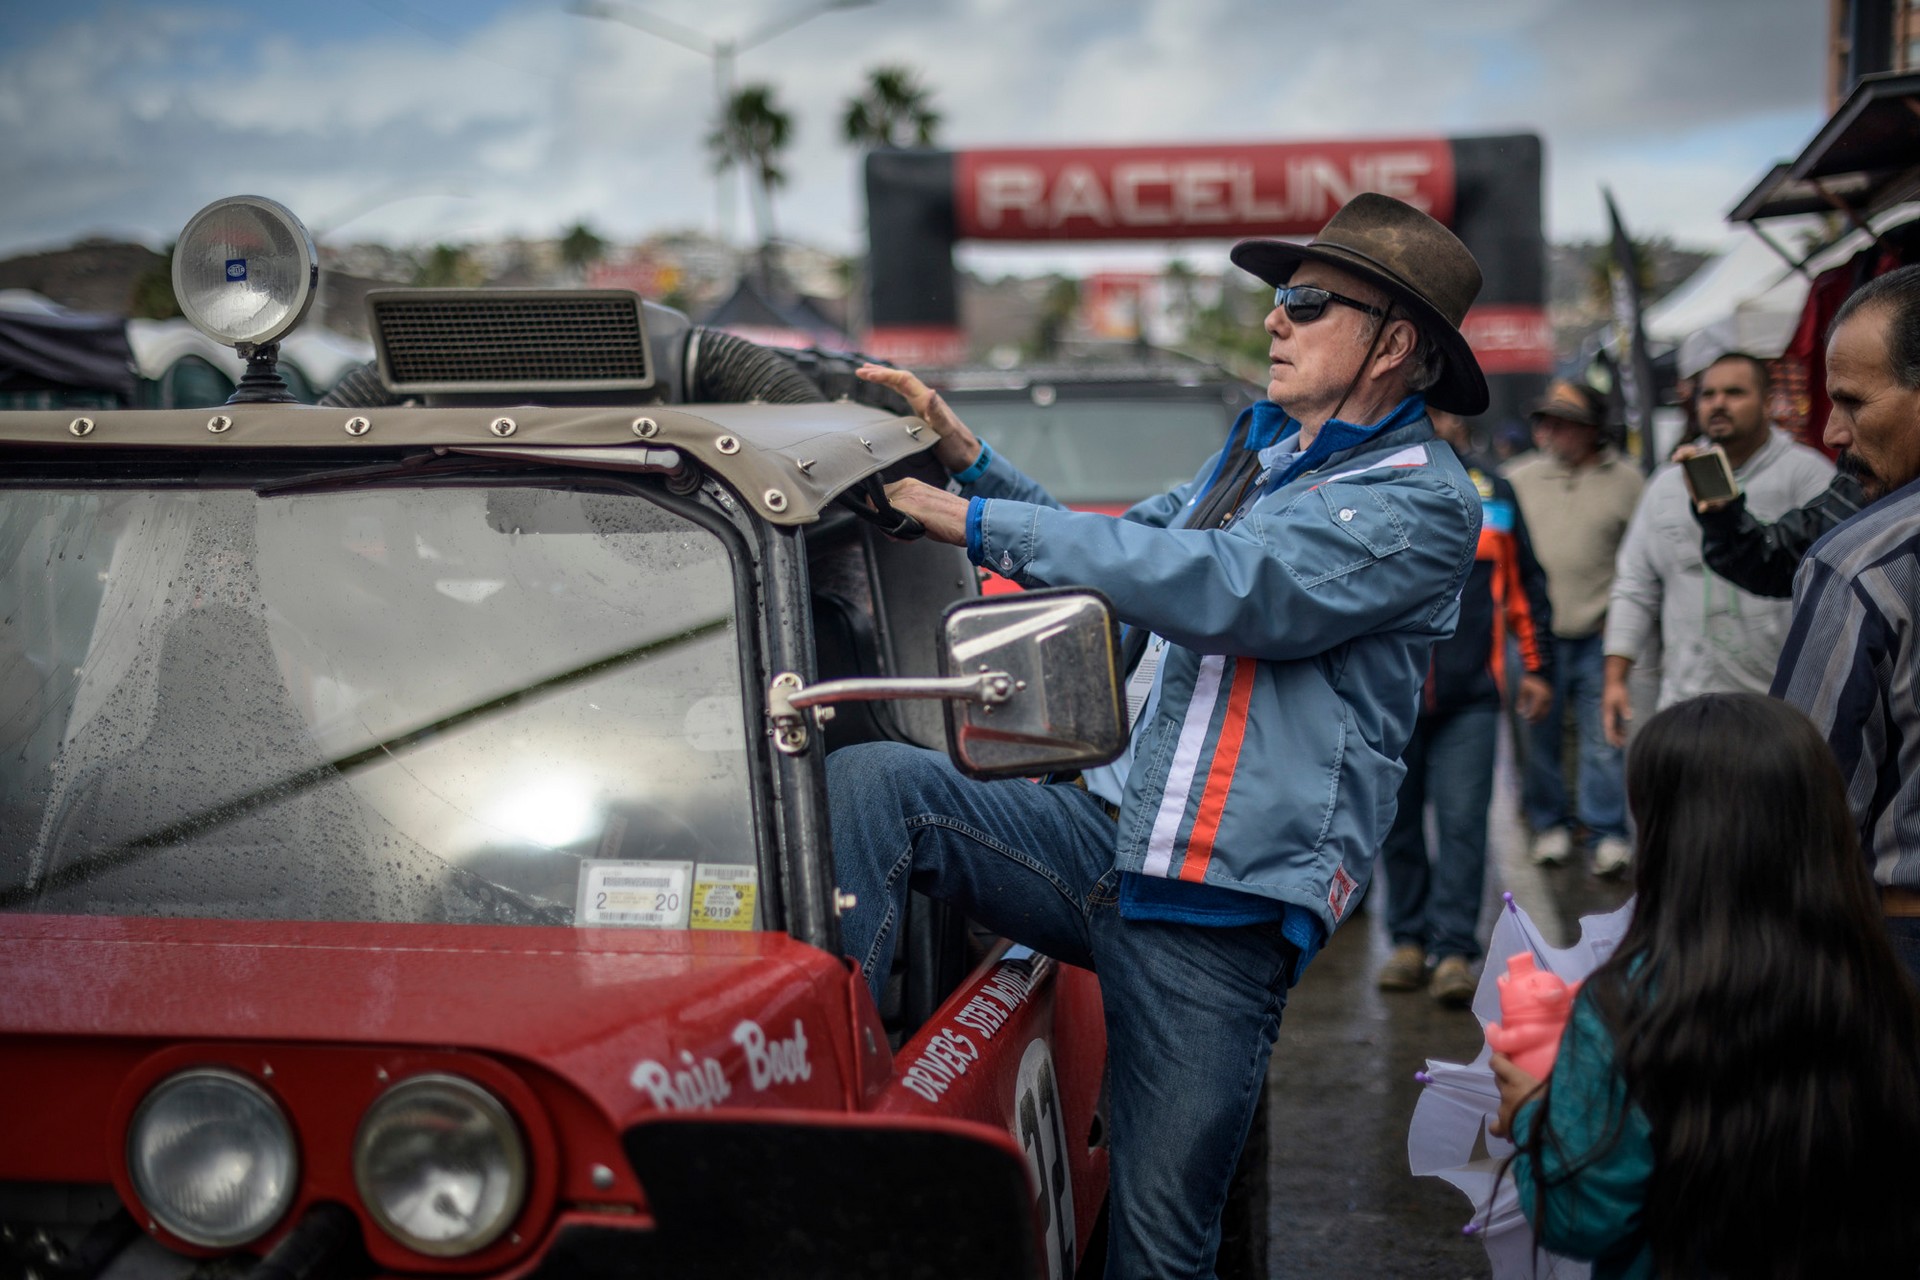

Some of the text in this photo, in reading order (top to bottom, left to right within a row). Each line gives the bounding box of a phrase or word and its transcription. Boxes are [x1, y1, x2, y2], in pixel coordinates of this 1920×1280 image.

[975, 151, 1432, 228] RACELINE
[596, 892, 607, 909] 2
[655, 893, 679, 911] 20
[703, 906, 731, 917] 2019
[731, 1018, 811, 1091] Boot
[902, 1028, 978, 1103] DRIVERS
[954, 995, 1009, 1039] STEVE
